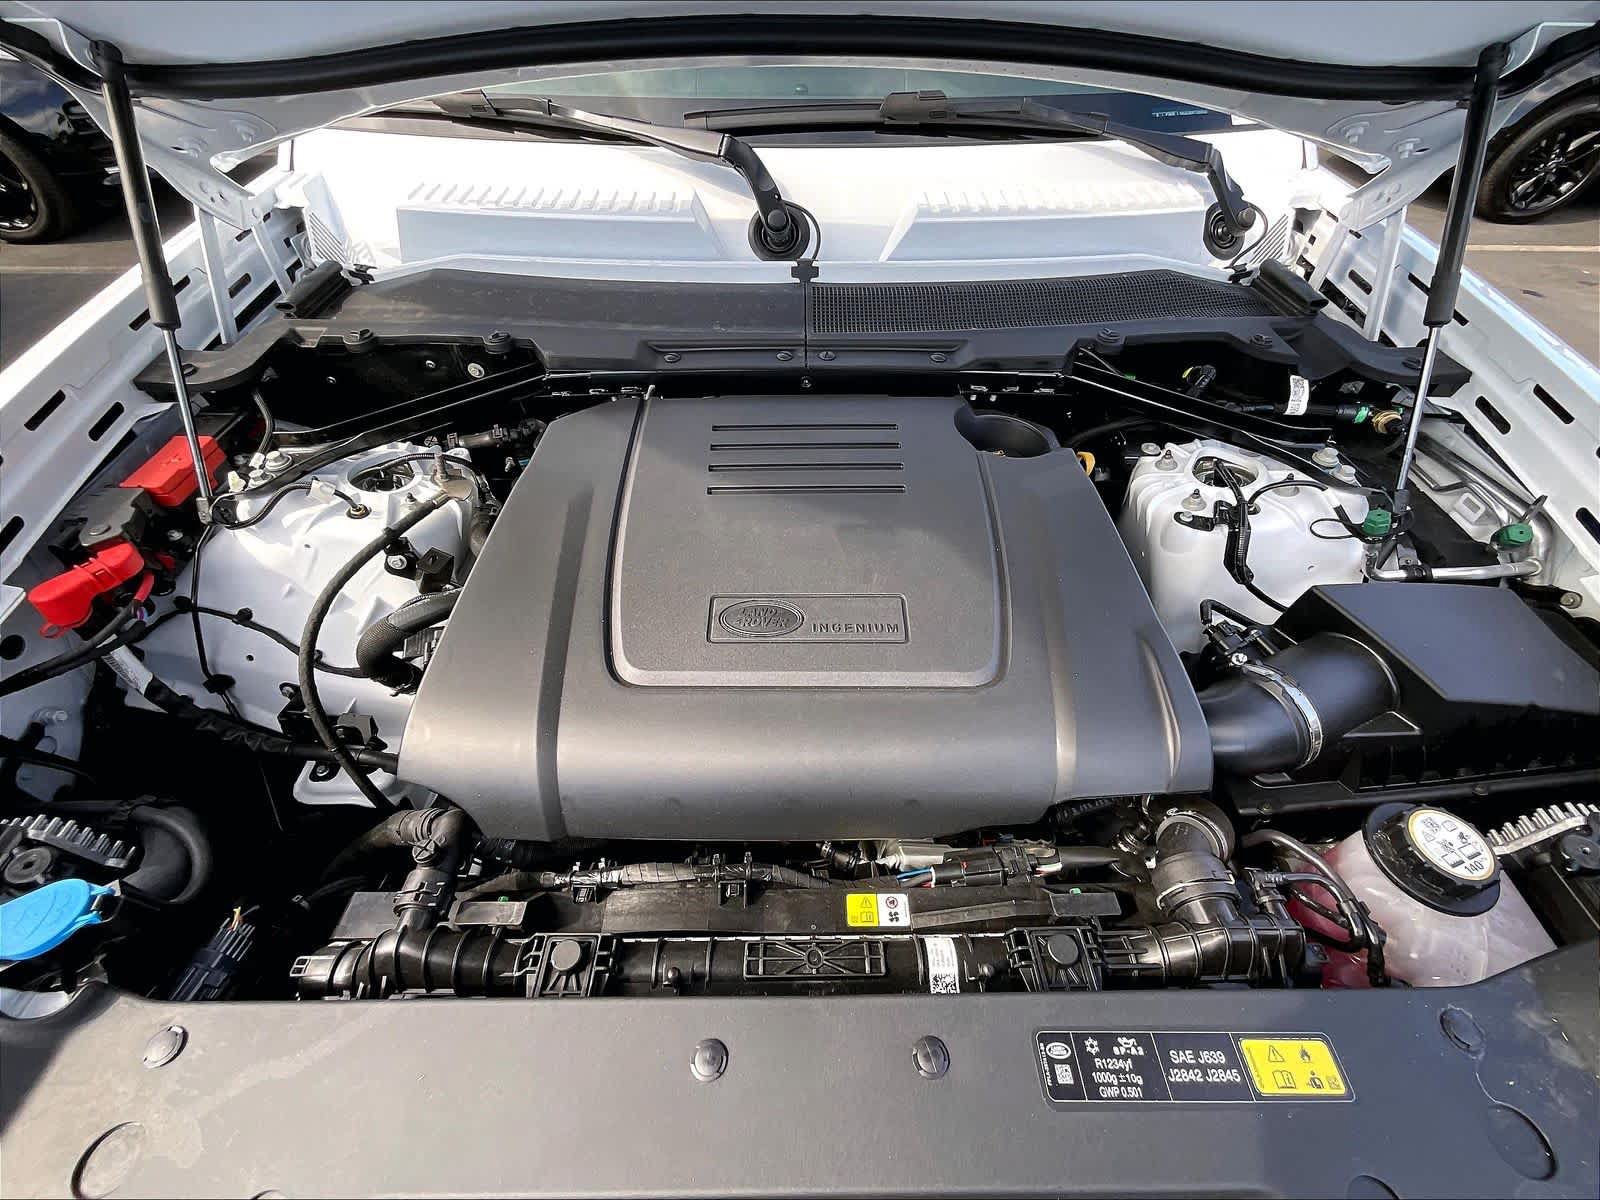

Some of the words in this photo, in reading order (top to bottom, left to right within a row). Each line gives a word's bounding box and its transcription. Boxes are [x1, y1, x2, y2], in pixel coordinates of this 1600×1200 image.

[811, 623, 900, 633] INGENIUM
[1169, 1049, 1196, 1064] SAE
[1197, 1050, 1226, 1064] J639
[1094, 1057, 1133, 1072] R1234yf
[1091, 1071, 1118, 1086] 1000g
[1119, 1073, 1144, 1085] ±10g
[1168, 1068, 1204, 1082] J2842
[1205, 1068, 1241, 1082] J2845
[1099, 1086, 1120, 1098] GWP
[1120, 1086, 1144, 1098] 0.501
